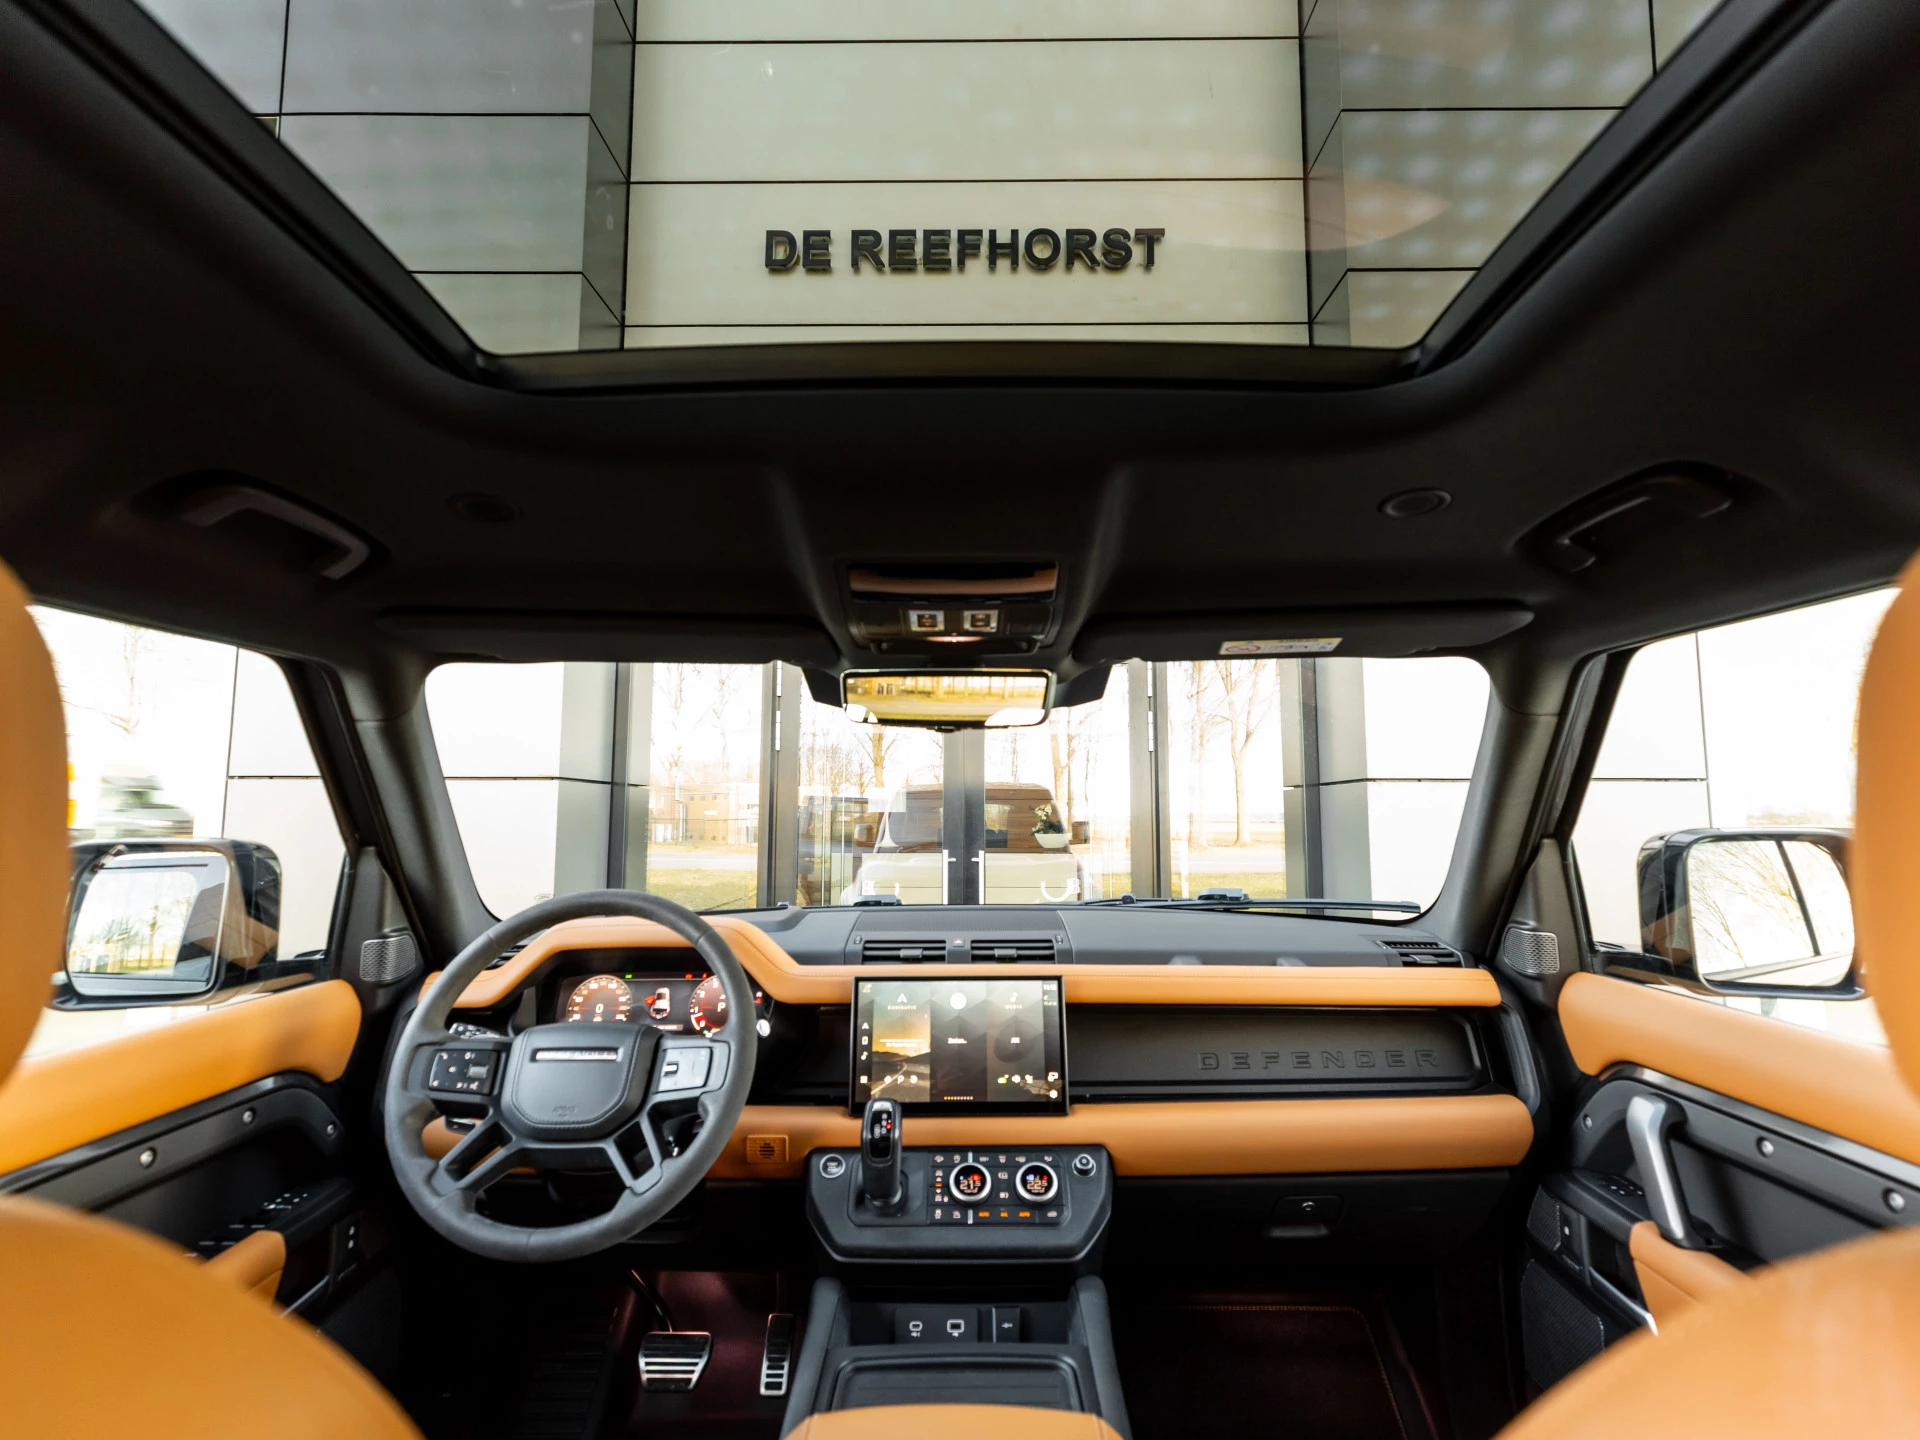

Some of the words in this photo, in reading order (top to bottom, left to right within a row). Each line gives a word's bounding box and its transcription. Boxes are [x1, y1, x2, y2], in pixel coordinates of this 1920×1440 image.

[765, 229, 832, 272] DE
[851, 228, 1165, 271] REEFHORST
[595, 1003, 604, 1014] 0
[1198, 1050, 1440, 1071] DEFENDER
